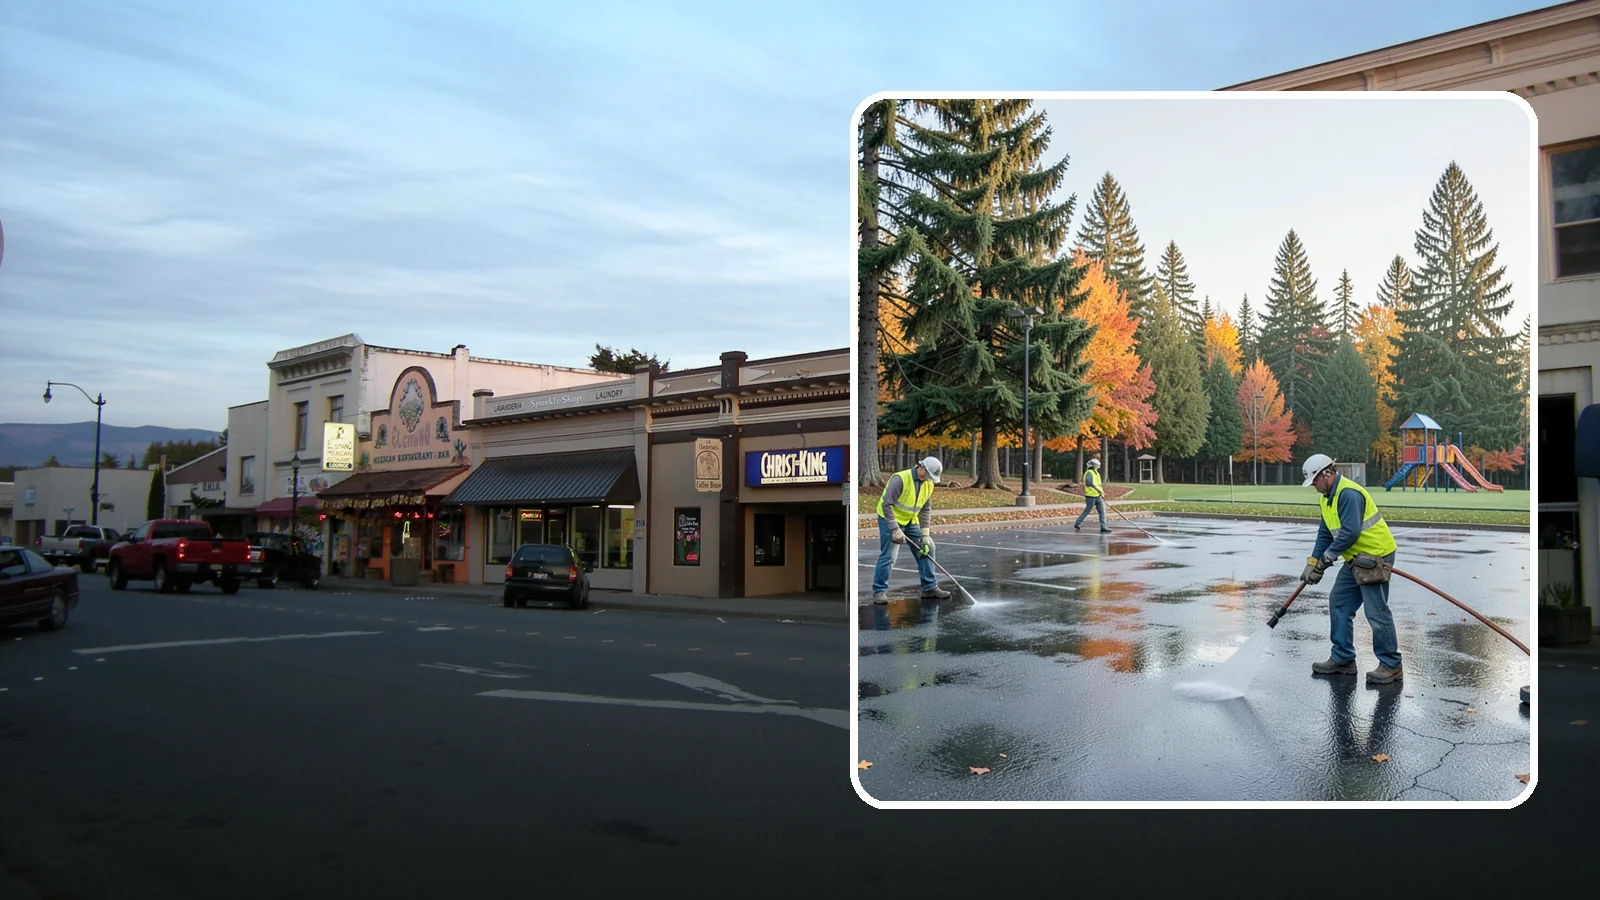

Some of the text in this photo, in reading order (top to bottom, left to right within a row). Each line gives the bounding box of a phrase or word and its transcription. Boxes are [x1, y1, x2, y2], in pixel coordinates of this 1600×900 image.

[530, 394, 582, 409] Sparkle Shop
[595, 389, 624, 400] LAUNDRY
[493, 402, 523, 413] LAVANDERIA
[373, 455, 396, 464] MEXICAN
[397, 451, 433, 462] RESTAURANT
[438, 450, 450, 459] BAR
[761, 450, 827, 478] CHRIST KING
